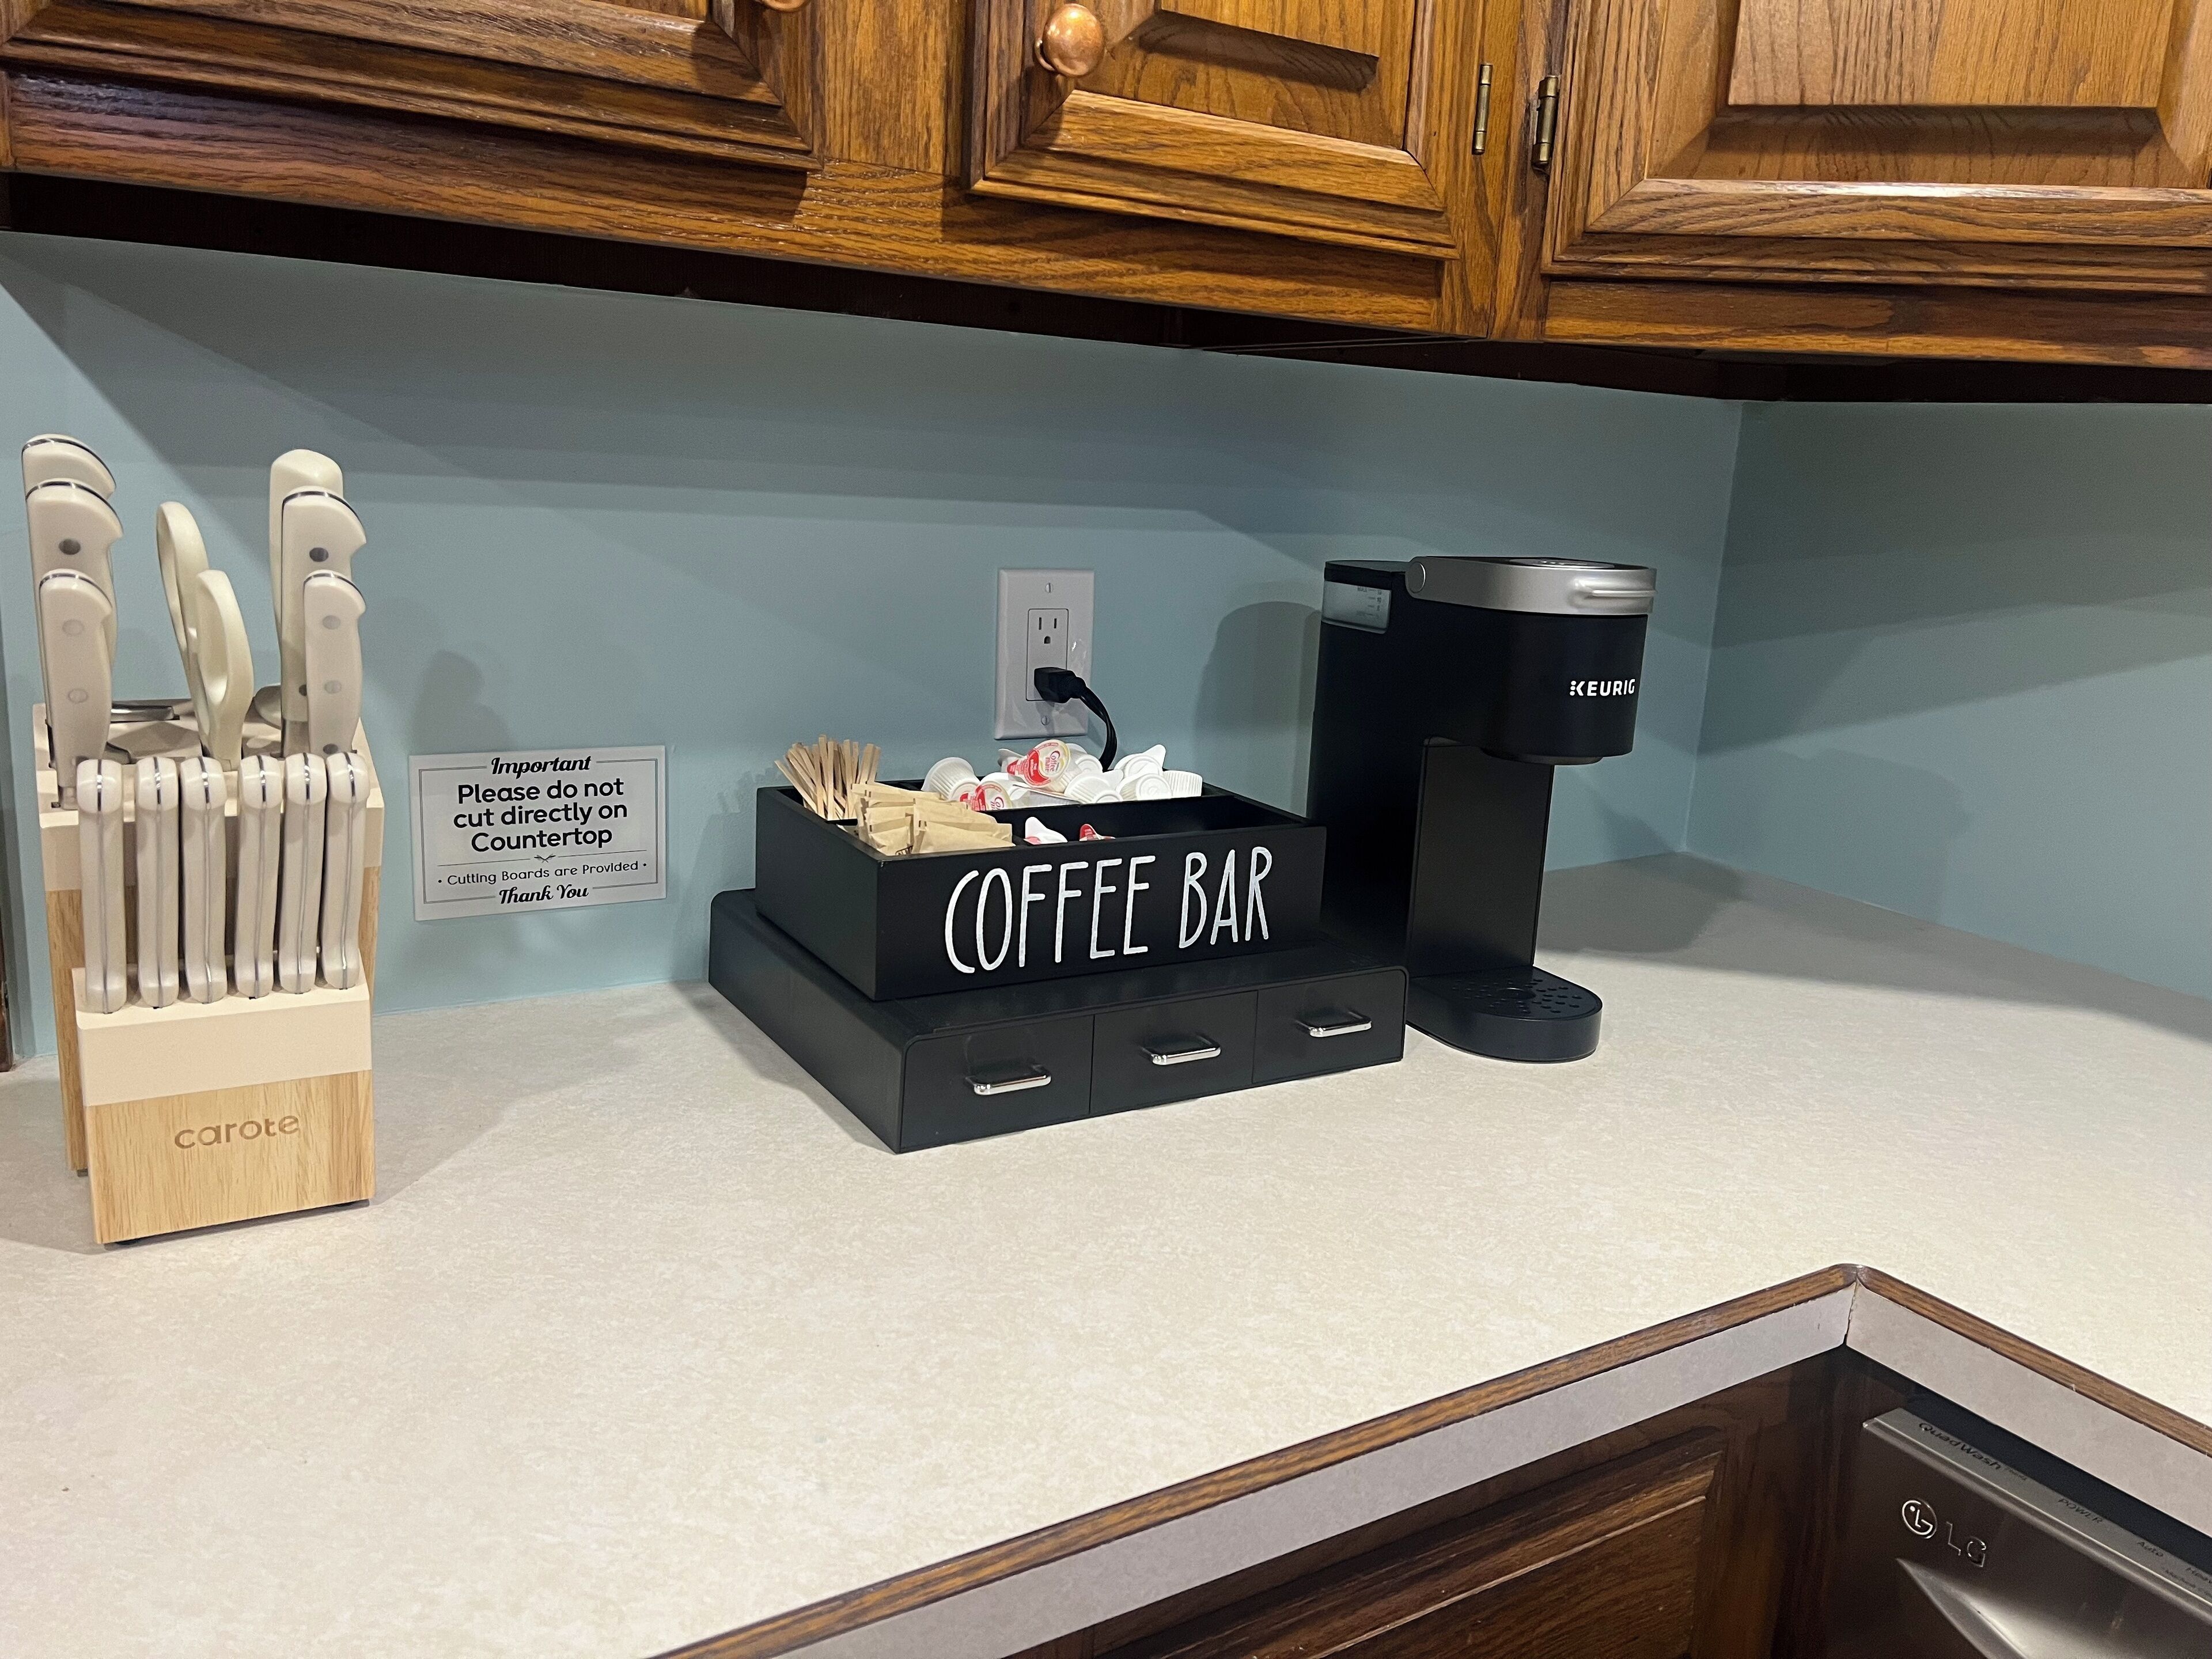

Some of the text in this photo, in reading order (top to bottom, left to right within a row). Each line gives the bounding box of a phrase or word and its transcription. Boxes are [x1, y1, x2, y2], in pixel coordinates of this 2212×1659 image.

[1569, 679, 1635, 696] KEURIG
[491, 756, 592, 779] Important
[458, 778, 624, 804] Please do not
[453, 802, 627, 828] cut directly on
[471, 828, 612, 852] Countertop
[447, 861, 638, 885] Cutting Boards are Provided
[499, 884, 589, 904] Thank You
[945, 846, 1272, 974] COFFEE BAR
[174, 1115, 299, 1149] carote
